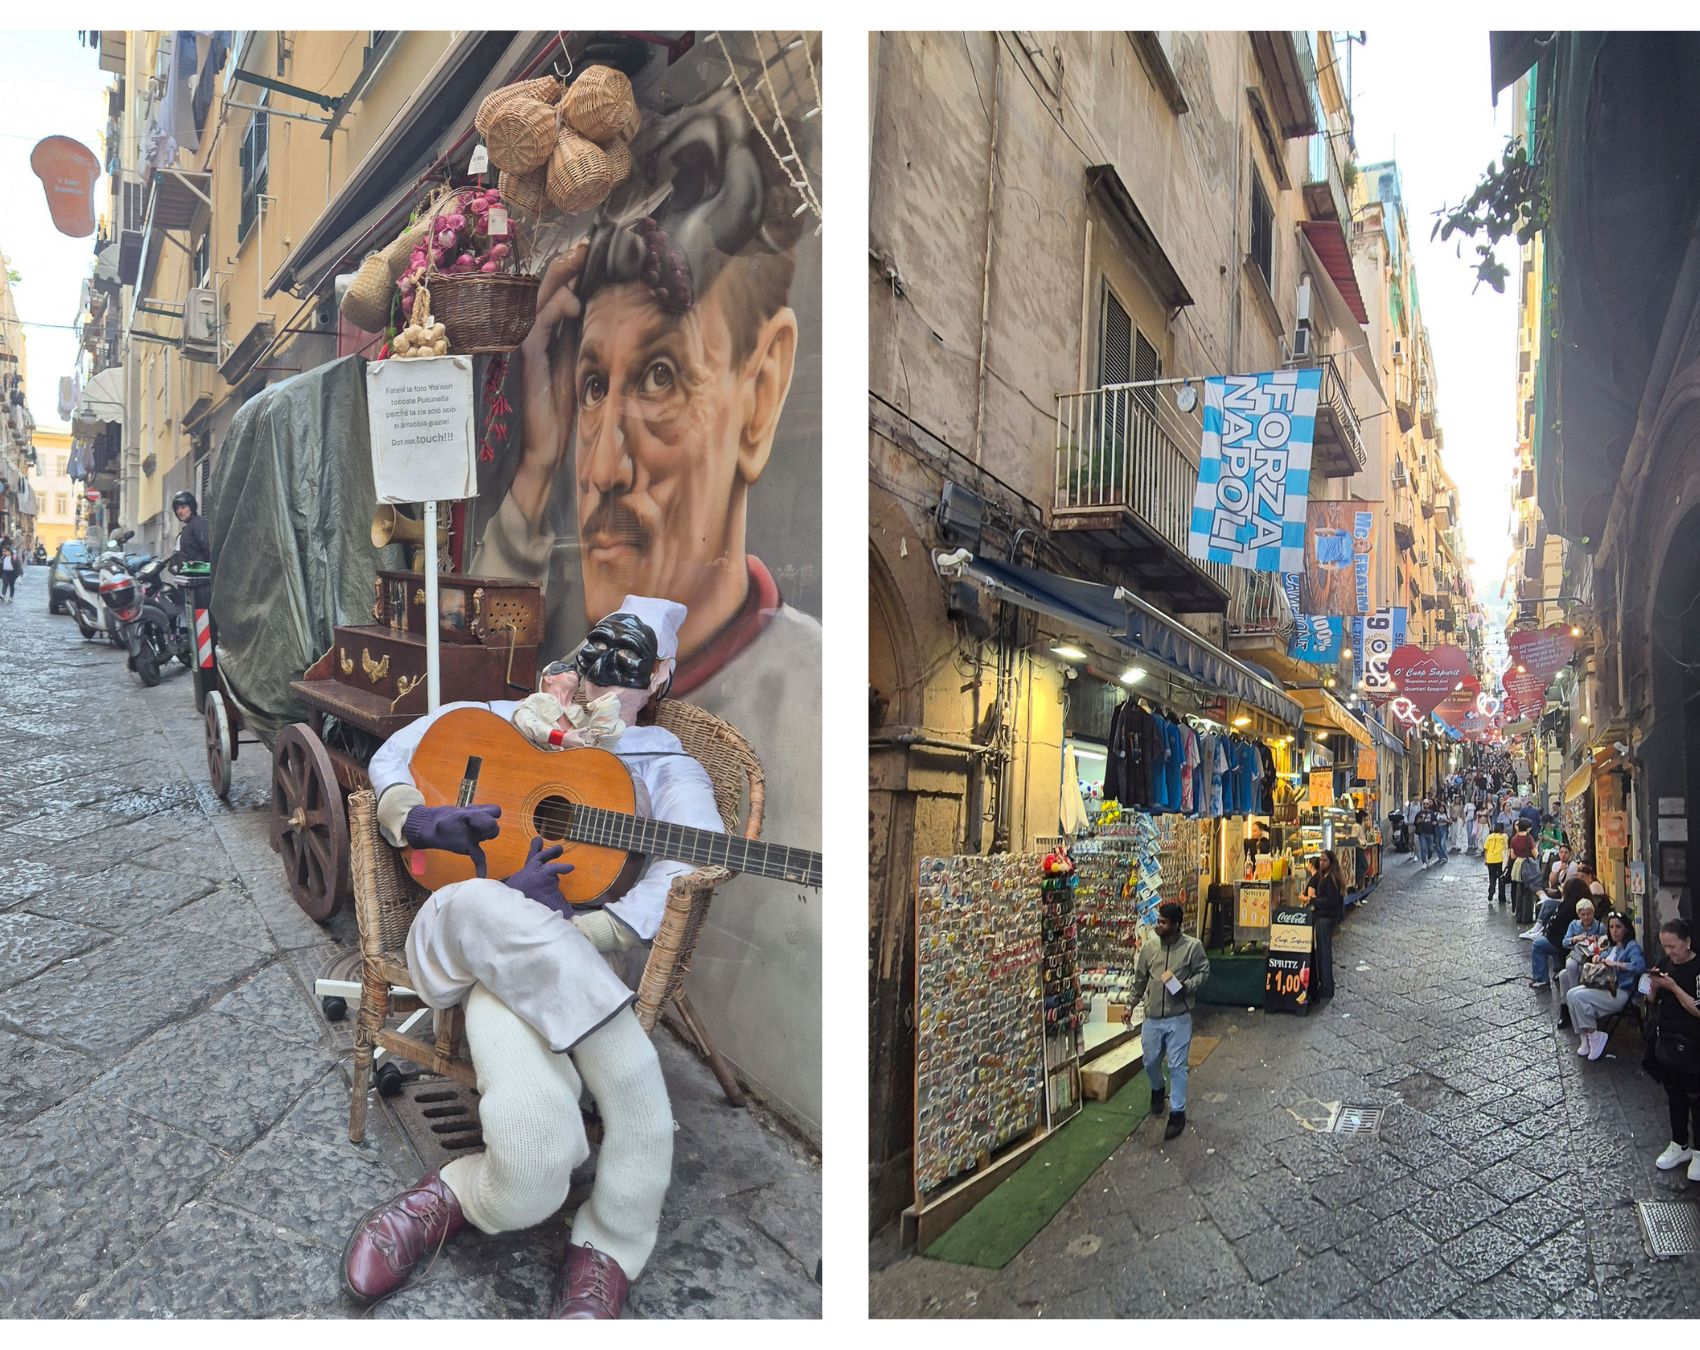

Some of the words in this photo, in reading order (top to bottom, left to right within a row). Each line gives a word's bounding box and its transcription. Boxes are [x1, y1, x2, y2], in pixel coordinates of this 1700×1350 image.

[391, 398, 416, 406] toccate
[417, 395, 449, 404] Pulcinella
[416, 432, 454, 444] touch!!!
[1208, 375, 1259, 553] NAPOLI
[1248, 383, 1297, 550] FORZA
[1354, 553, 1370, 613] FRATM
[1311, 615, 1333, 652] 100%
[1268, 958, 1298, 969] SPRITZ
[1275, 970, 1301, 995] 1,00
